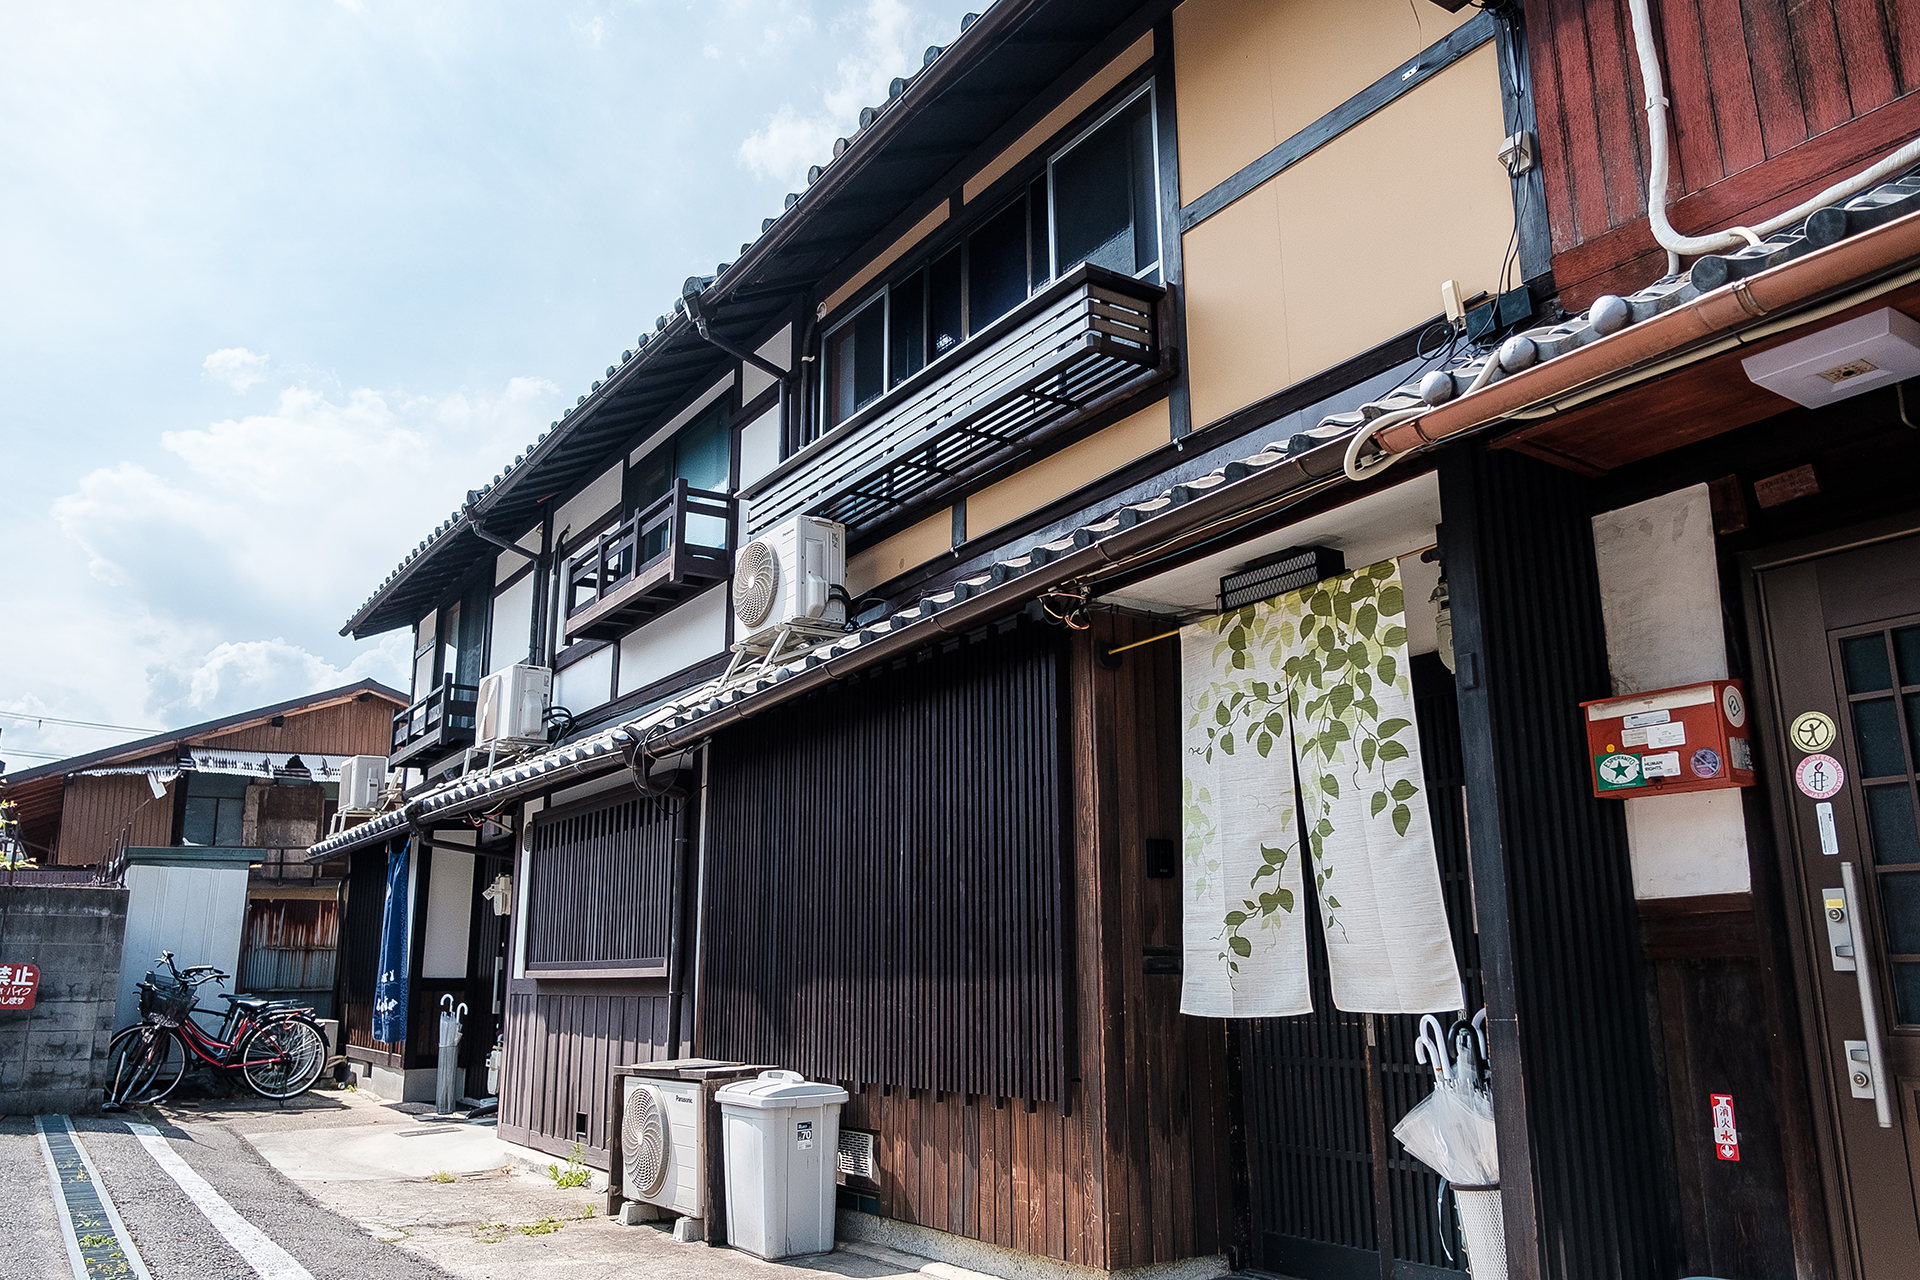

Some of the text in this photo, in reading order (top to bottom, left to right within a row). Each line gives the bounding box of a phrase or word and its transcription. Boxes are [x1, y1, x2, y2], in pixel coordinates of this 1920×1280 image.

[1603, 755, 1635, 769] ESPERANTO
[0, 996, 25, 1005] します
[801, 1130, 812, 1140] 70
